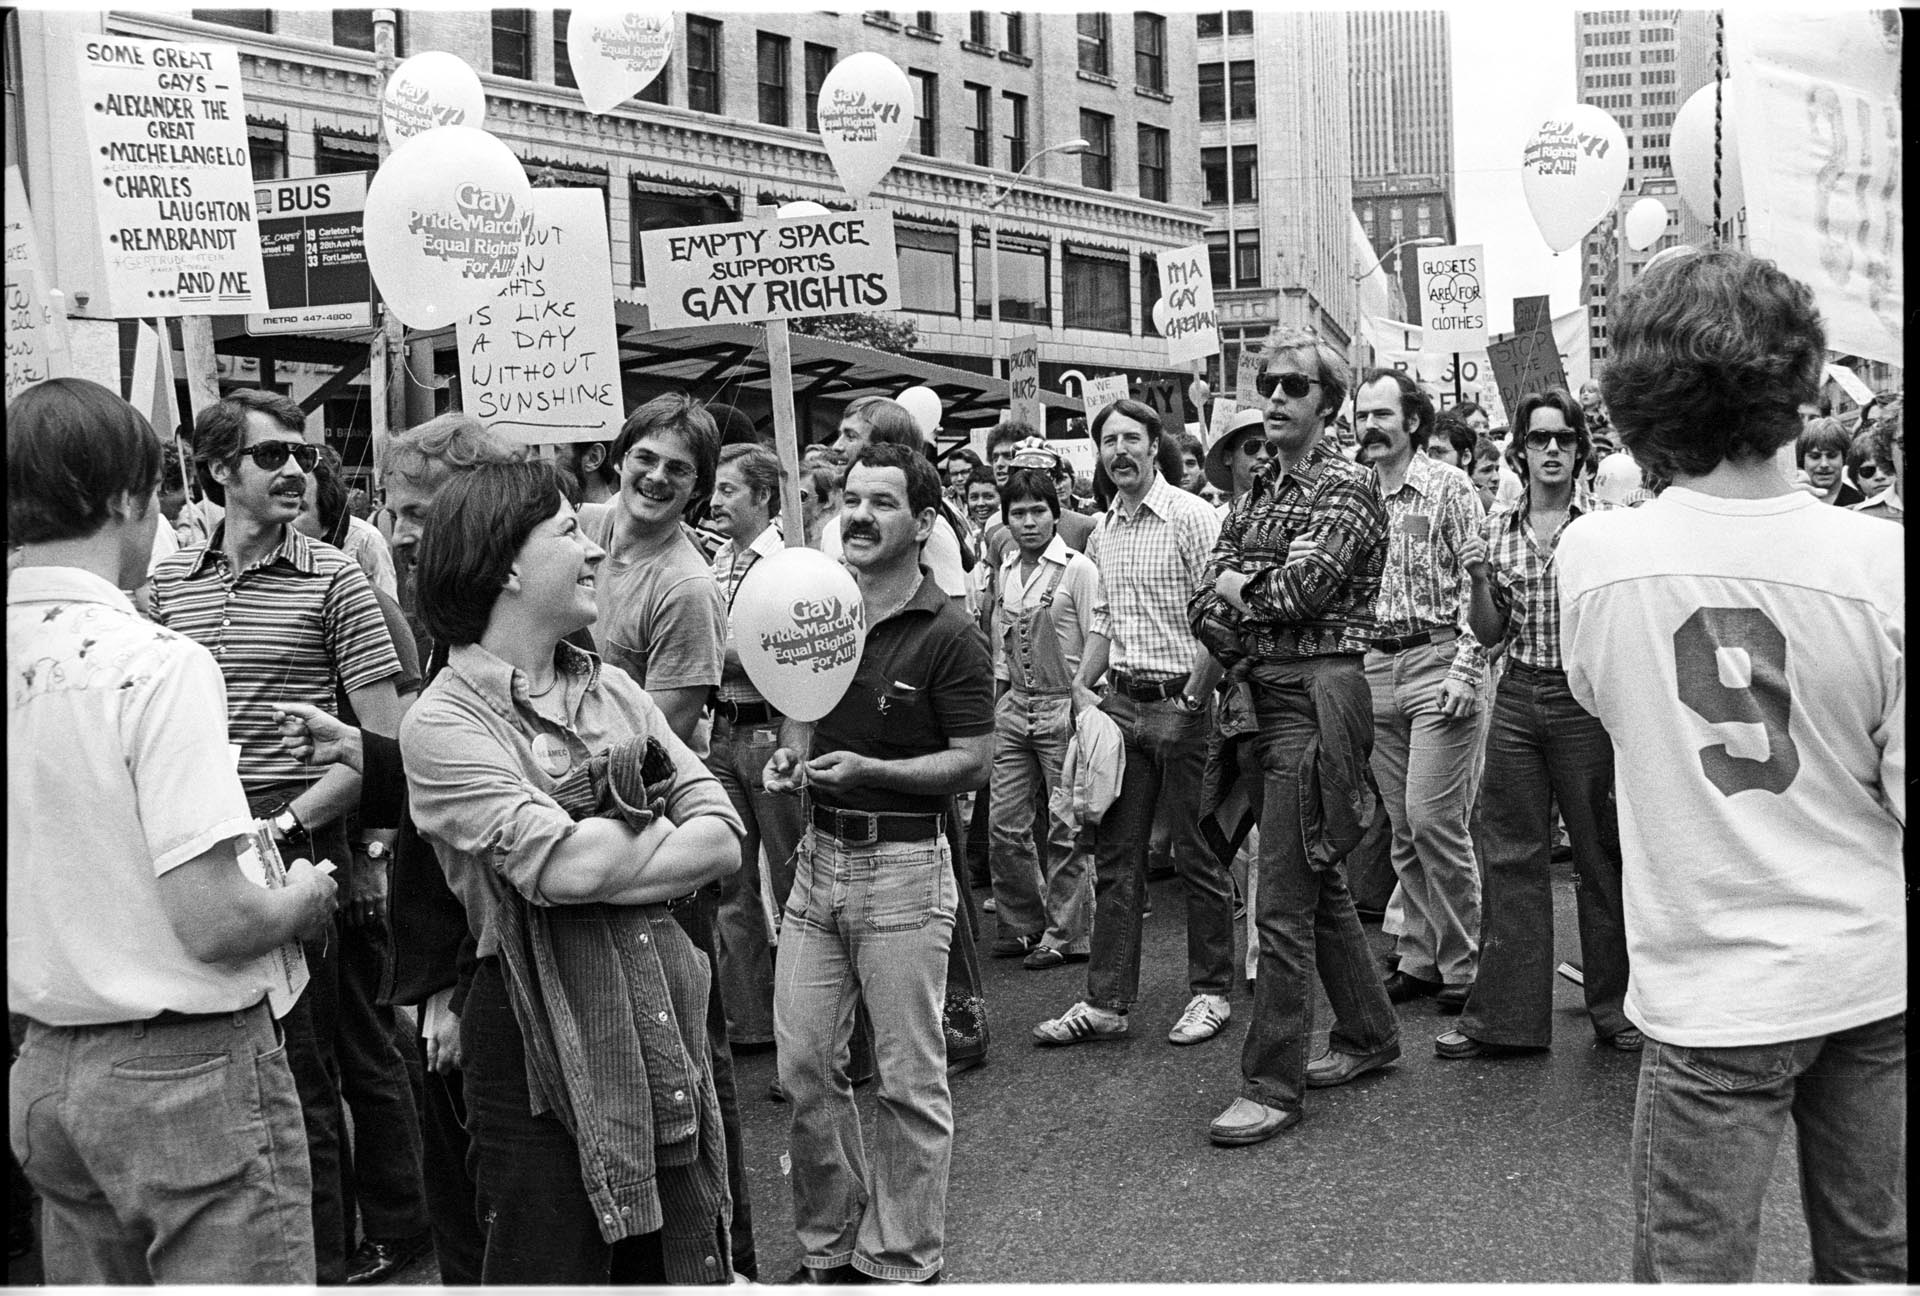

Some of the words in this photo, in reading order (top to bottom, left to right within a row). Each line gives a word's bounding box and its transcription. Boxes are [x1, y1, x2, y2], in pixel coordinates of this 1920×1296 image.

[86, 43, 145, 65] SOME
[152, 47, 213, 70] GREAT
[158, 73, 207, 93] GAYS
[105, 93, 195, 119] ALEXANDER
[201, 100, 230, 120] THE
[833, 88, 865, 107] Gay
[147, 121, 195, 140] GREAT
[109, 142, 246, 166] MICHELANGELO
[115, 175, 192, 198] CHARLES
[278, 183, 331, 212] BUS
[158, 200, 251, 222] LAUGHTON
[455, 181, 514, 218] Gay
[408, 208, 461, 232] Pride
[464, 214, 520, 235] March
[120, 228, 237, 251] REMBRANDT
[306, 229, 316, 242] 19
[318, 227, 350, 237] Carleton
[351, 225, 364, 234] Par
[668, 229, 769, 262] EMPTY
[778, 220, 870, 249] SPACE
[261, 245, 281, 254] unset
[282, 243, 295, 253] Hill
[306, 242, 317, 255] 24
[319, 241, 336, 250] 28th
[336, 240, 350, 249] Ave
[423, 234, 469, 254] Equal
[475, 237, 519, 257] Rights
[307, 255, 318, 268] 33
[322, 254, 336, 262] Fort
[336, 252, 362, 262] Lawton
[463, 258, 488, 273] For
[490, 258, 516, 274] All!
[708, 252, 835, 280] SUPPORTS
[1189, 258, 1203, 278] A
[218, 272, 252, 294] ME
[1429, 287, 1451, 301] ARE
[1458, 285, 1482, 301] FOR
[682, 282, 757, 322] GAY
[764, 272, 888, 314] RIGHTS
[1169, 286, 1199, 310] GAY
[303, 312, 353, 323] 447-4800
[515, 300, 576, 322] LIKE
[1515, 299, 1540, 321] GAY
[1432, 315, 1484, 331] CLOTHES
[472, 333, 492, 354] A
[511, 325, 576, 352] DAY
[1495, 331, 1546, 364] STOP
[472, 352, 598, 386] WITHOUT
[1512, 357, 1541, 376] THE
[1095, 379, 1111, 391] WE
[478, 383, 614, 418] SUNSHINE
[789, 596, 840, 621] Gay
[760, 625, 801, 646] Pride
[801, 612, 853, 639] March
[775, 643, 812, 662] Equal
[815, 632, 855, 653] Rights
[811, 655, 833, 669] For
[835, 643, 857, 663] All!
[1673, 606, 1800, 797] 9
